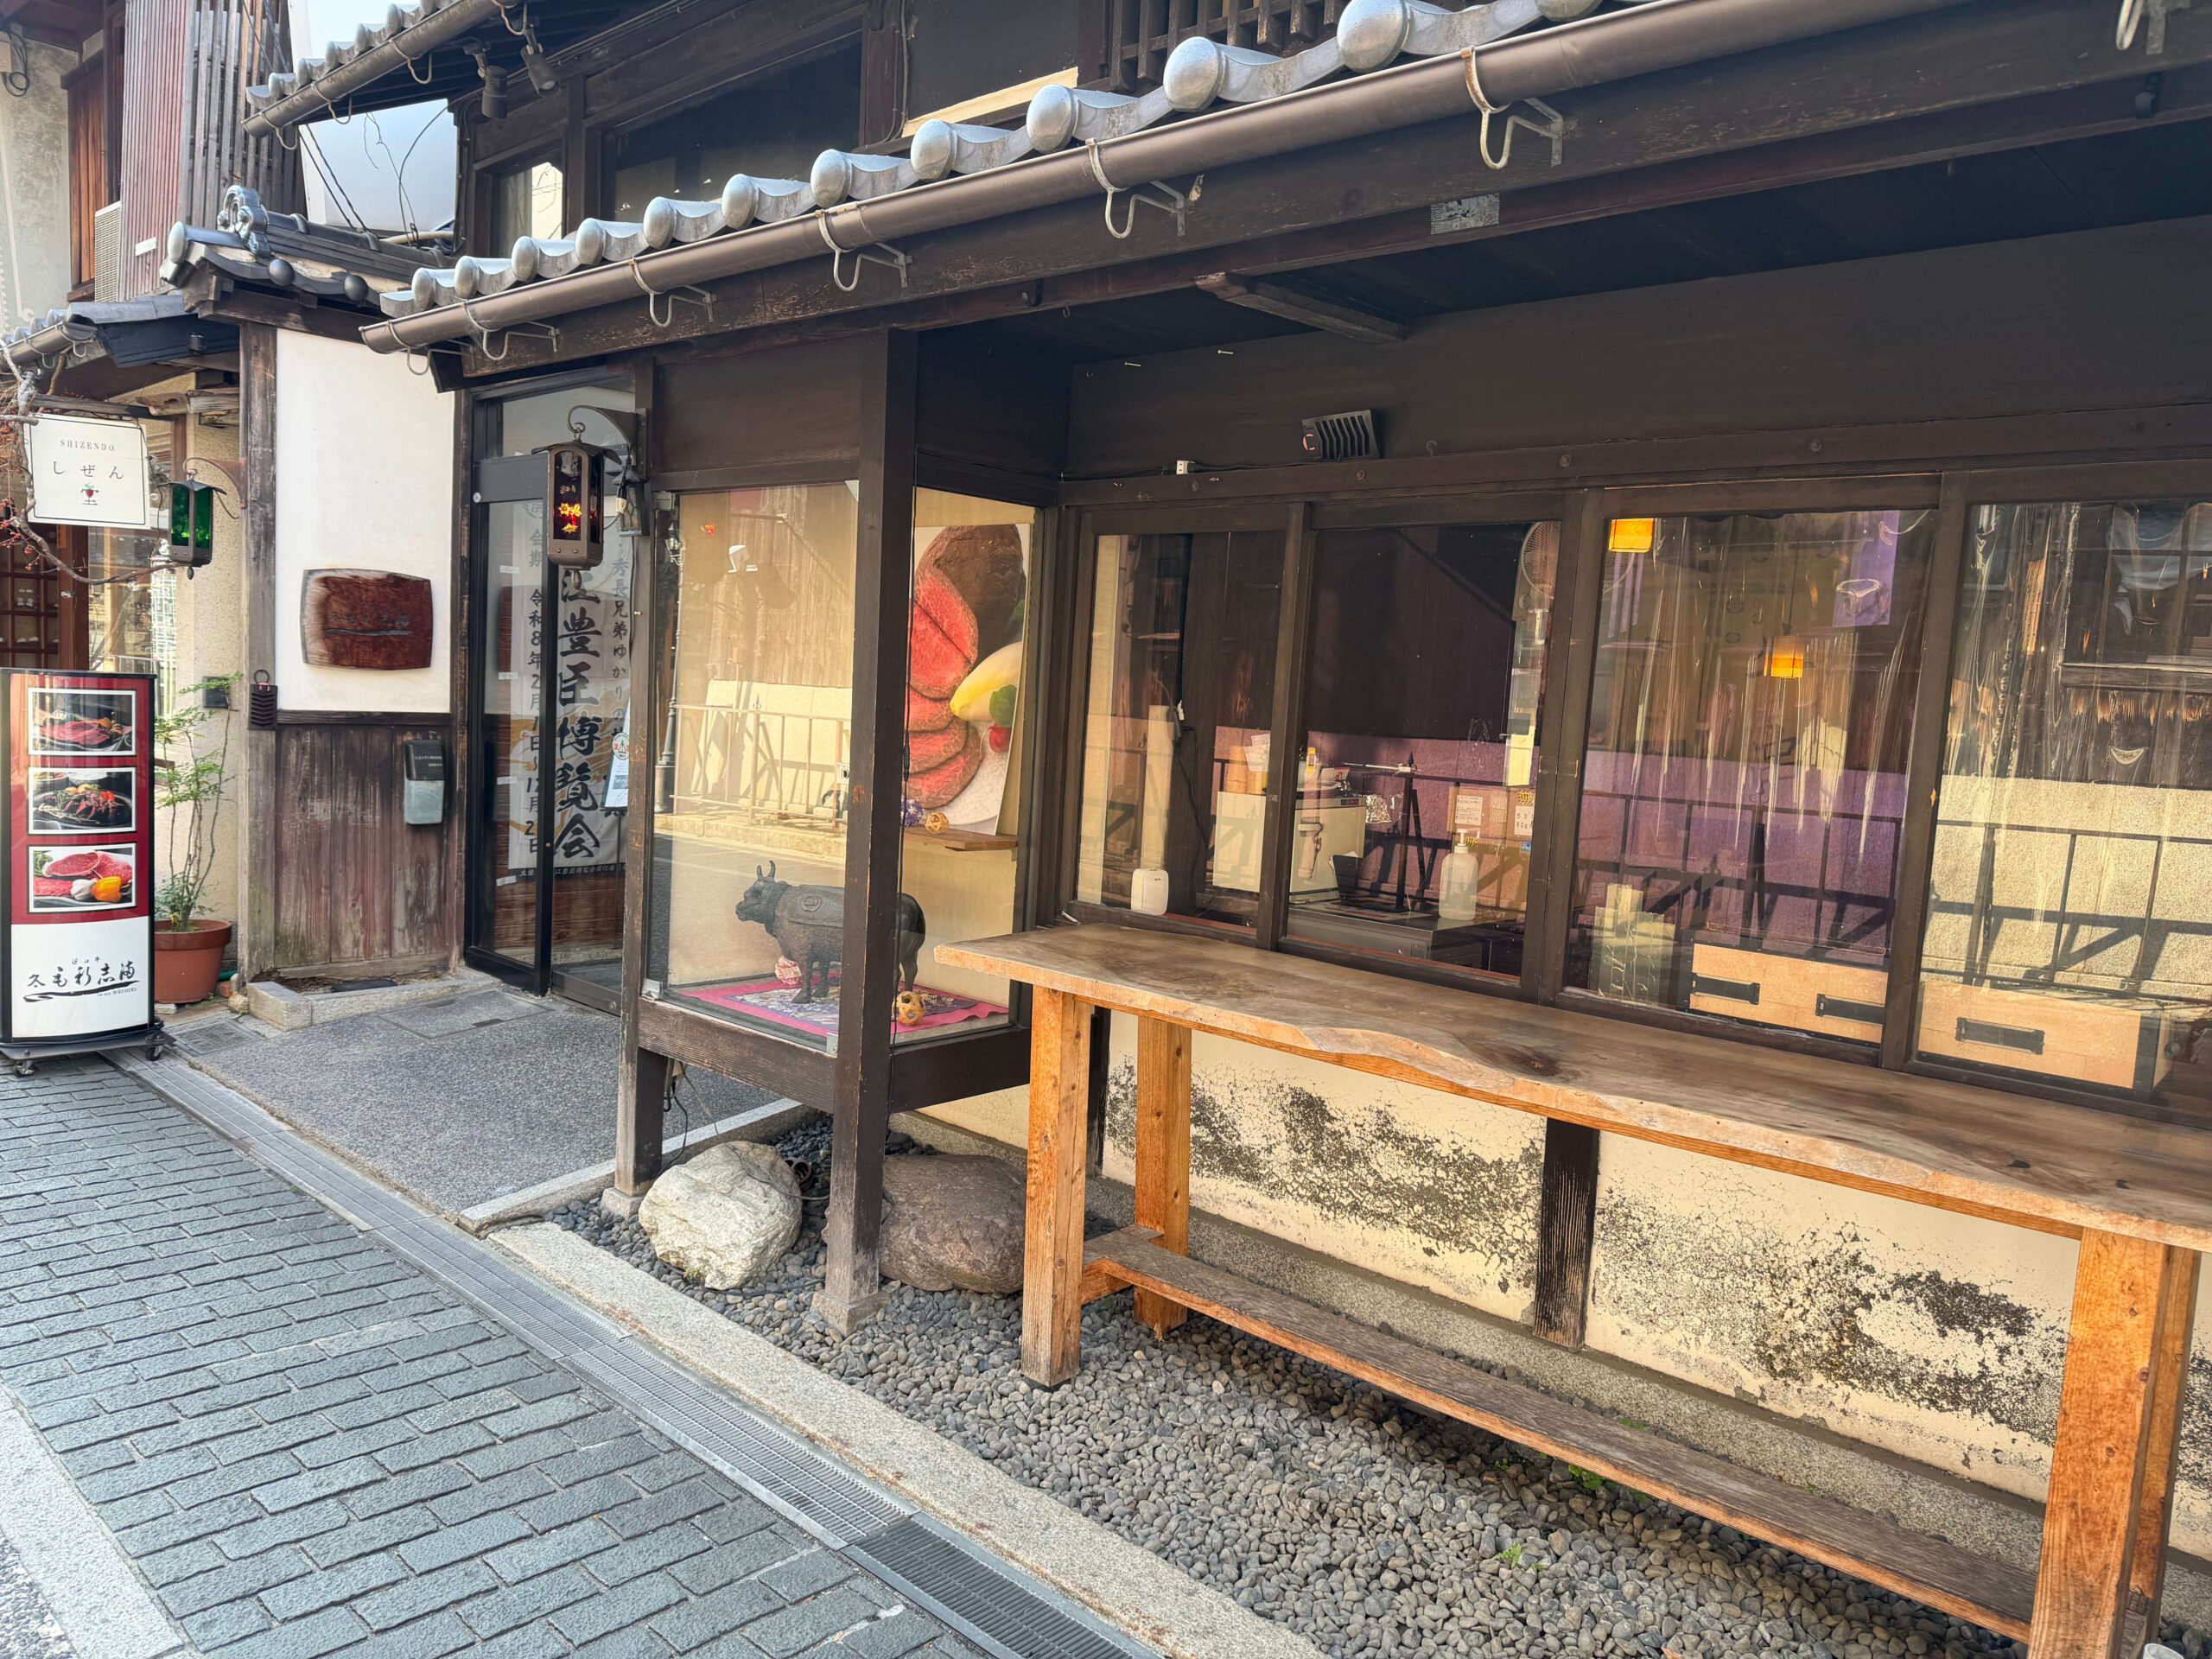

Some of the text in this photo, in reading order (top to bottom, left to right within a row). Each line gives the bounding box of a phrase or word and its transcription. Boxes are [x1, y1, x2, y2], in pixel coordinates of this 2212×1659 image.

[60, 439, 115, 451] SHIZENDO
[52, 461, 124, 480] しぜん
